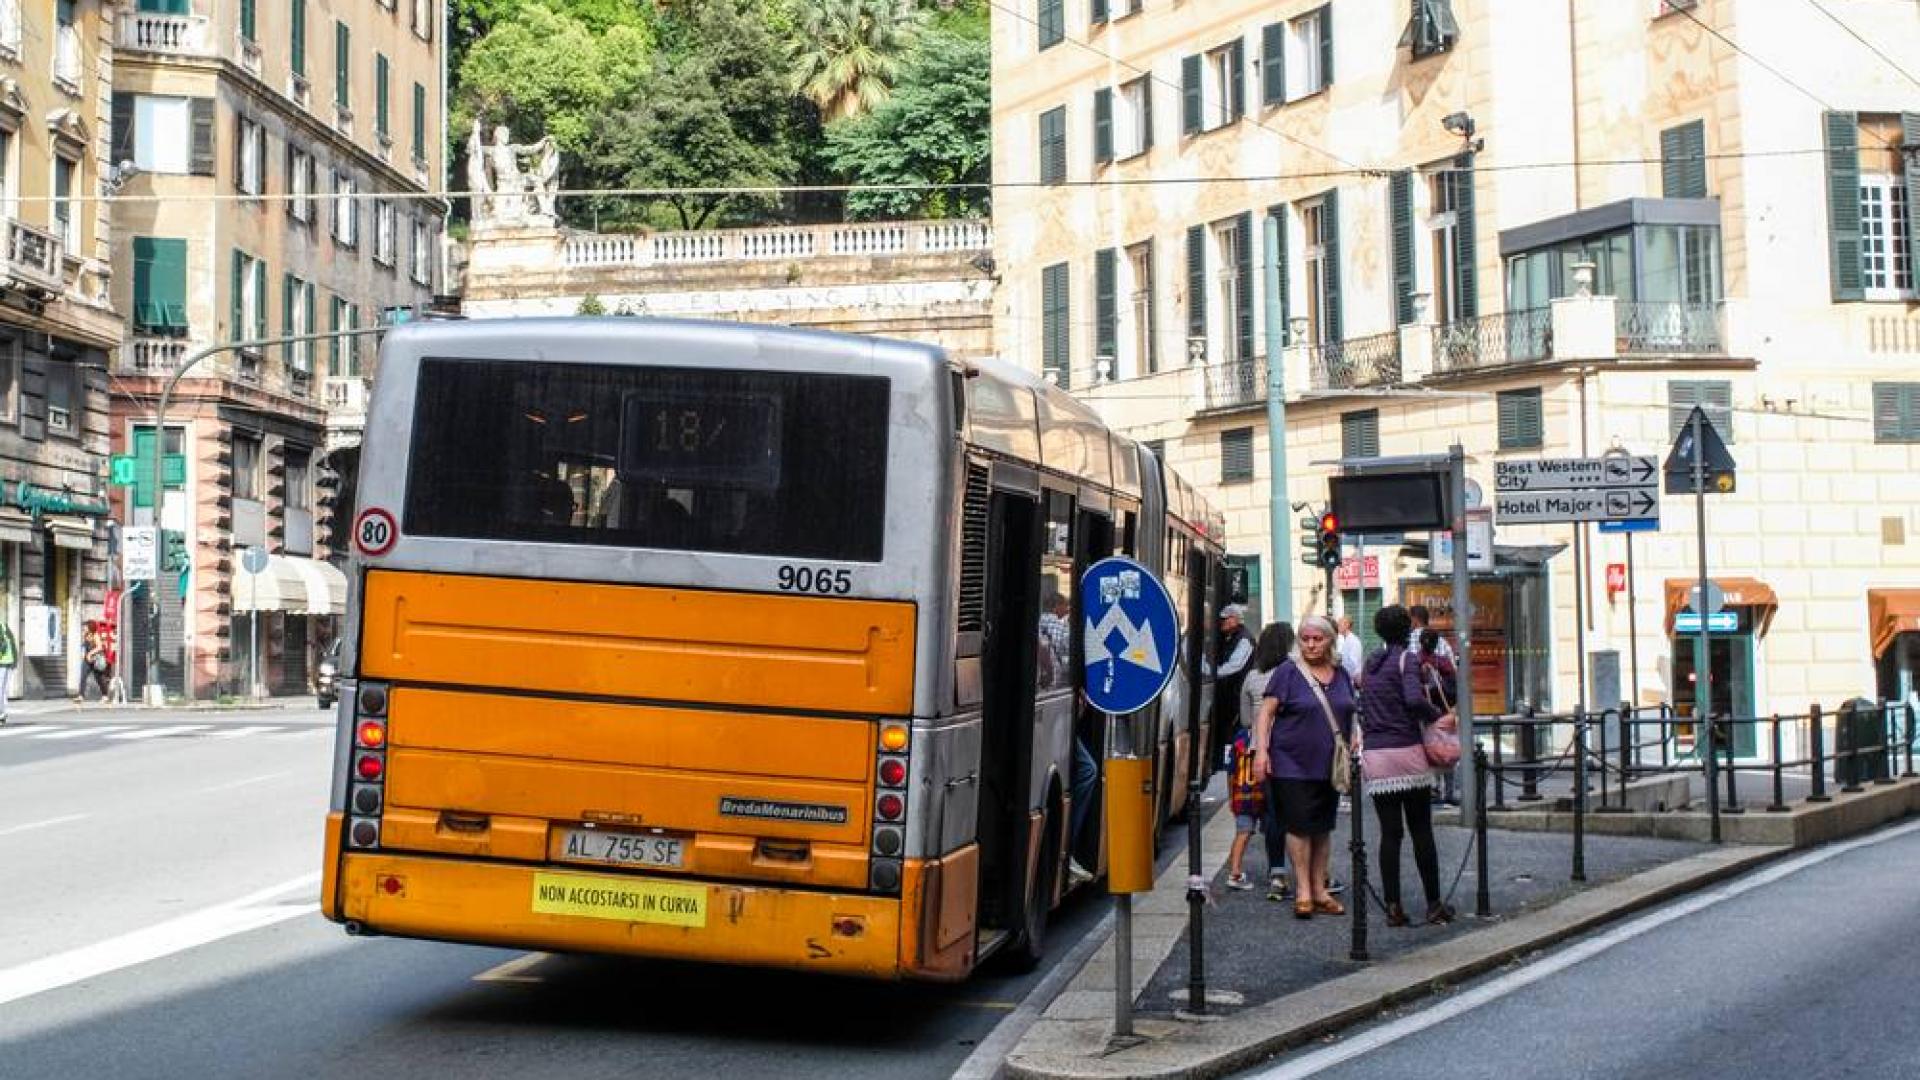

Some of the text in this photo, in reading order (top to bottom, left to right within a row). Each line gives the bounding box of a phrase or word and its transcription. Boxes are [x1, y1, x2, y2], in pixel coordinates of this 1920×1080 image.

[1497, 460, 1602, 475] Best Western
[1497, 475, 1529, 490] City
[1497, 498, 1593, 515] Hotel Major
[363, 521, 388, 545] 80
[778, 565, 852, 596] 9065
[566, 833, 682, 865] AL 755 SF
[539, 884, 699, 915] NON ACCOSTARSI IN CURVA
